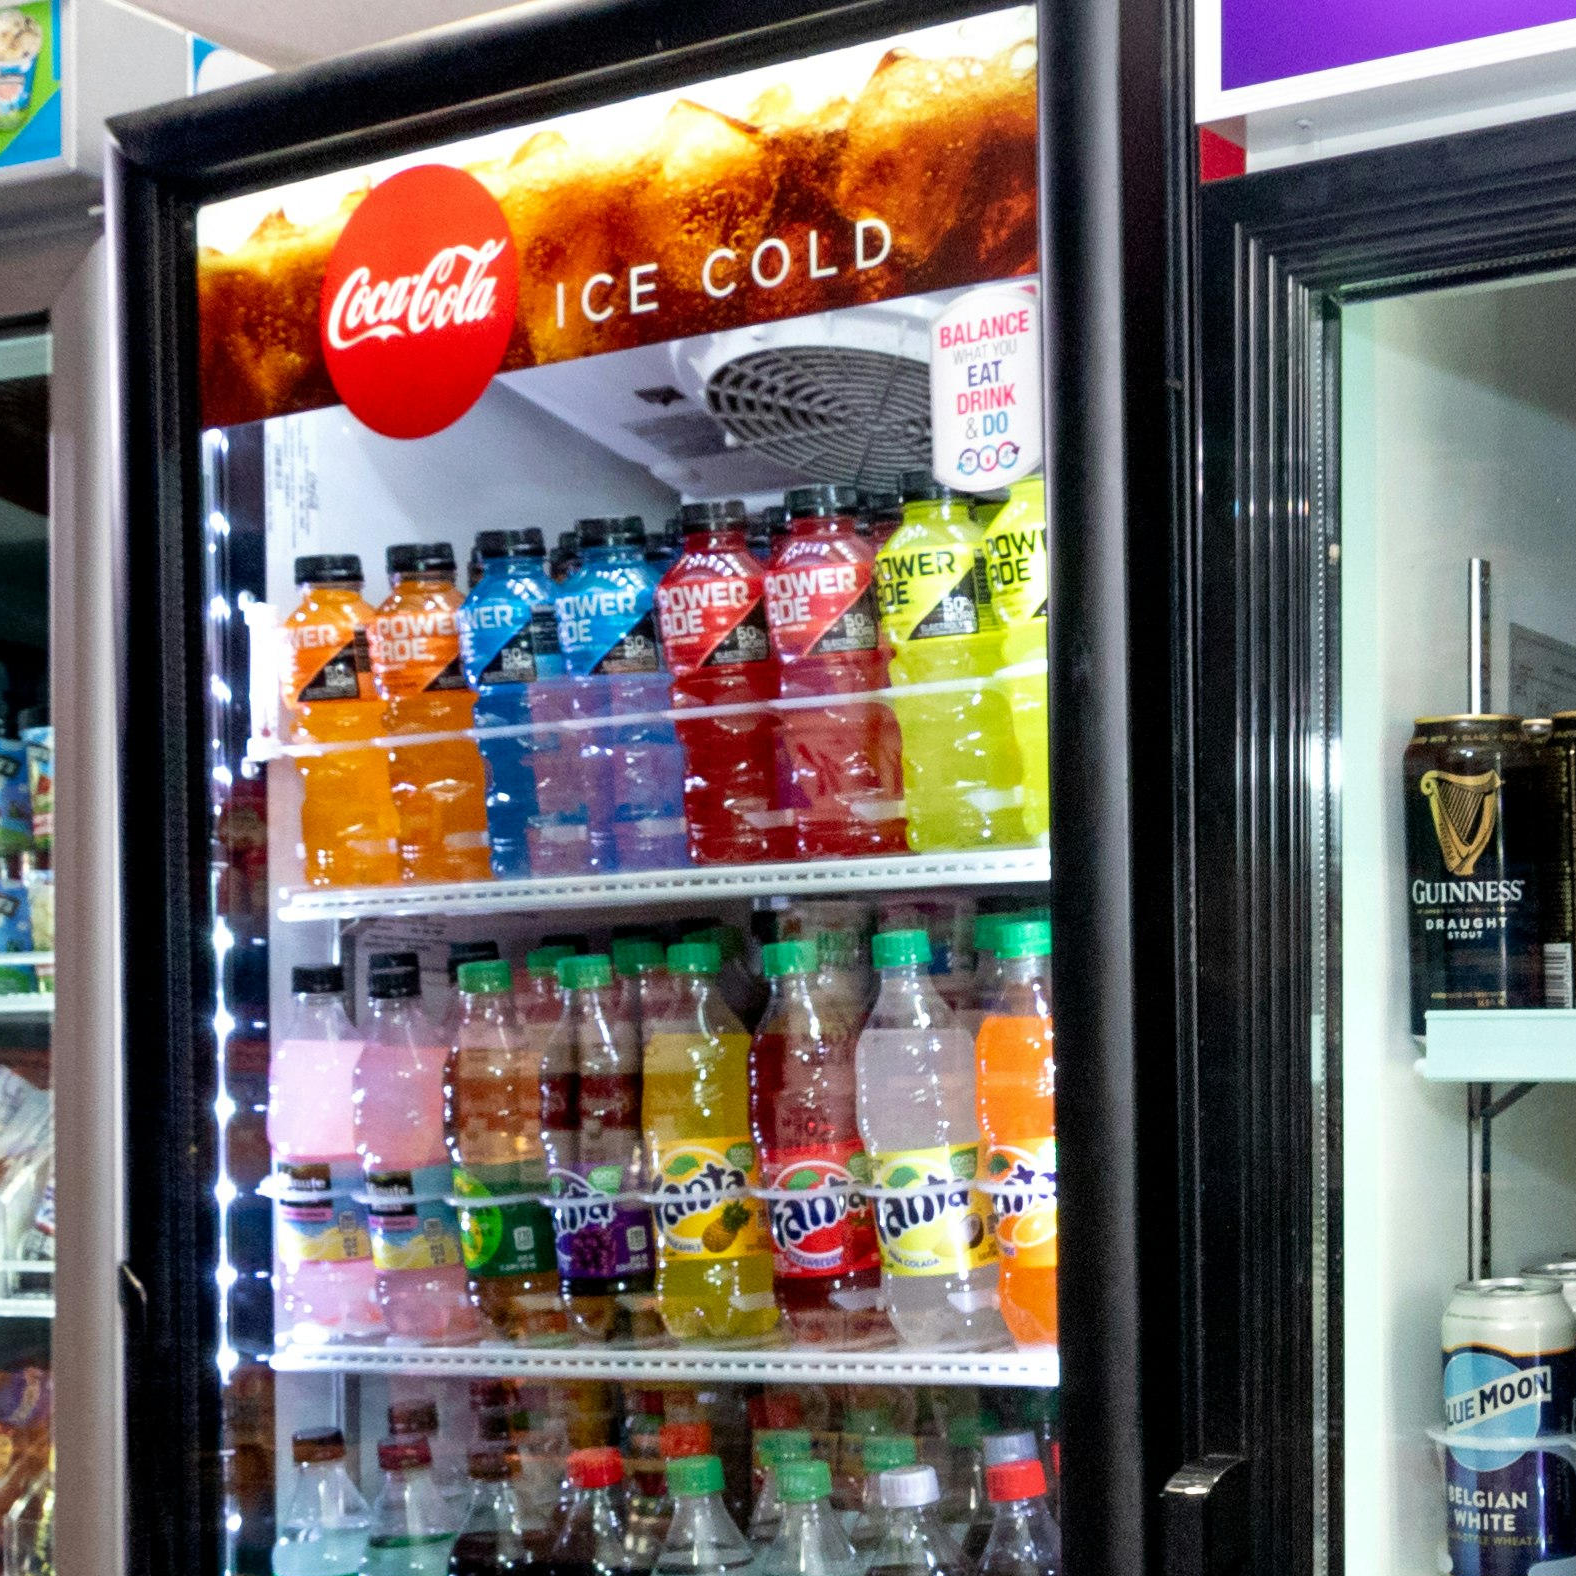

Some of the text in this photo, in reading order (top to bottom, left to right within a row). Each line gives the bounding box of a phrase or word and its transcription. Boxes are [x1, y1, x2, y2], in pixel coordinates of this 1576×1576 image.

[555, 217, 893, 329] ICE COLD
[329, 236, 506, 349] Coca-Cola
[940, 310, 1029, 348] BALANCE
[953, 338, 1017, 365] WHAT YOU
[967, 360, 1002, 387] EAT
[957, 384, 1016, 415] DRINK
[965, 410, 1009, 440] & DO
[985, 528, 1048, 560] POW
[377, 611, 459, 639] POWE
[1412, 878, 1523, 905] GUINNESS
[1425, 917, 1508, 932] DRAUGHT
[1447, 931, 1483, 941] STOUT
[1447, 1370, 1551, 1426] LUE MOON
[1449, 1485, 1528, 1510] BELGIAN
[1454, 1508, 1517, 1533] WHITE
